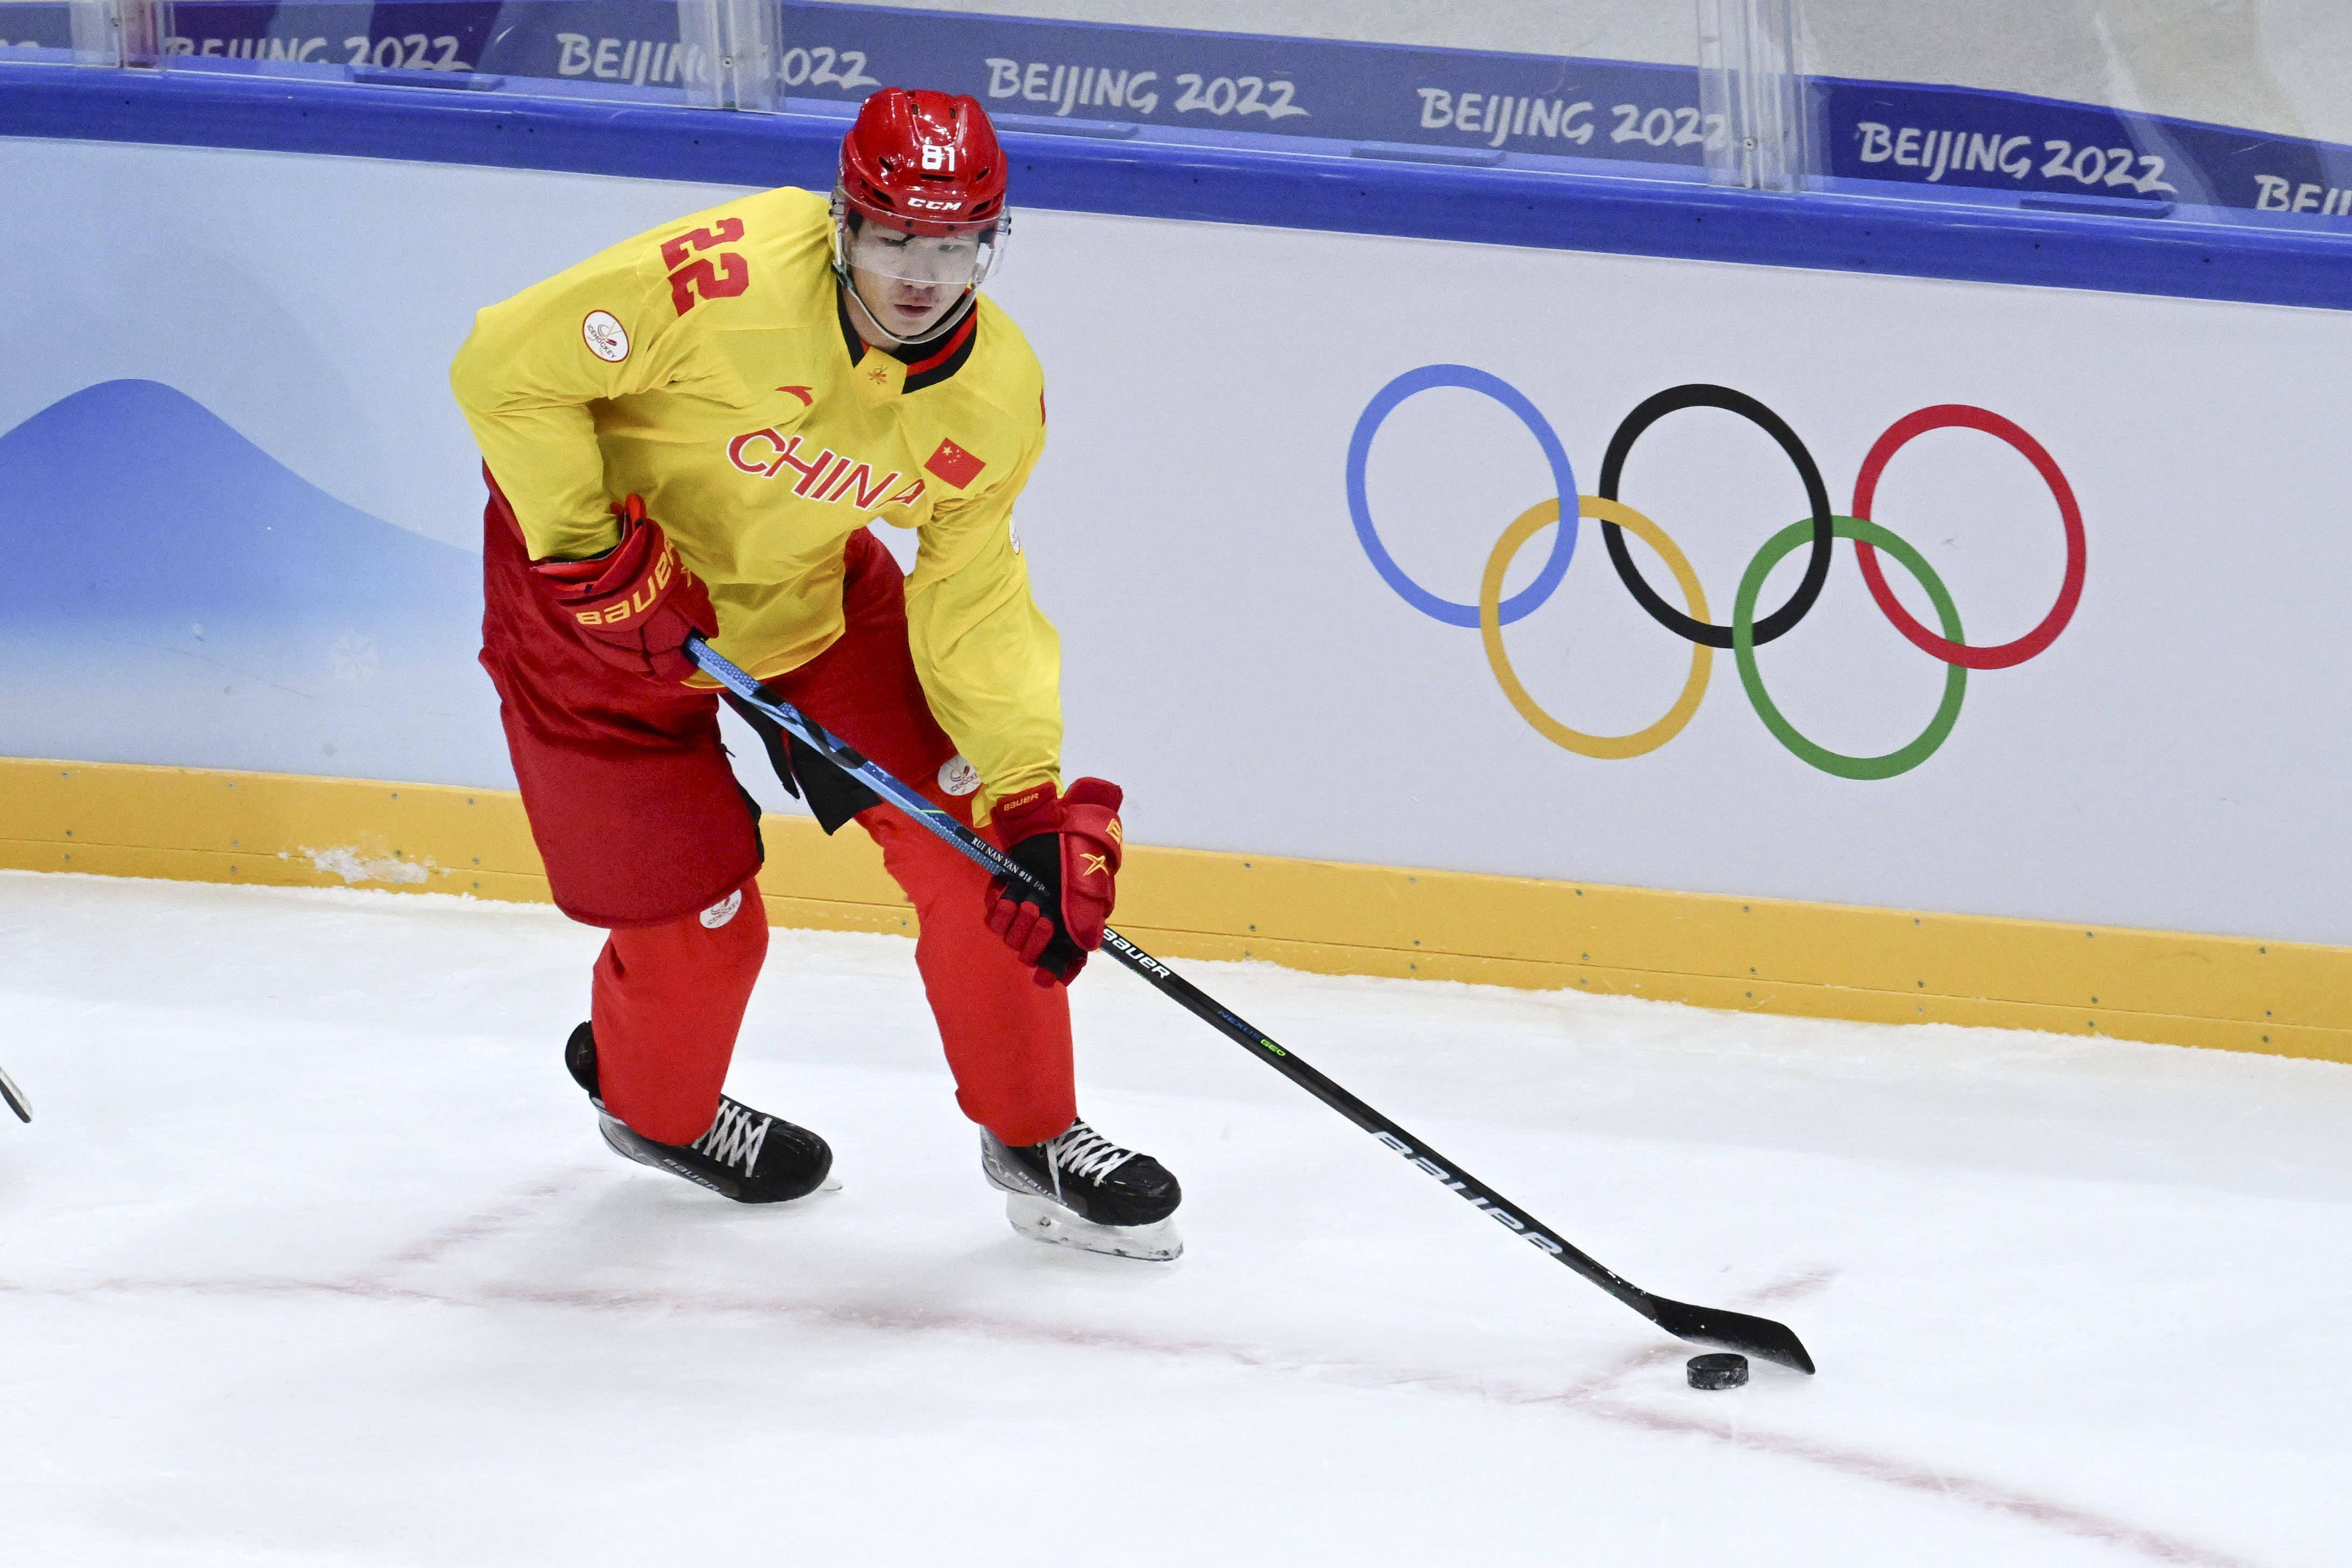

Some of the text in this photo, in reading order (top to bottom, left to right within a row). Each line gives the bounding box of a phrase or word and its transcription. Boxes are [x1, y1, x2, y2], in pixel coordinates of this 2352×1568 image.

[344, 34, 474, 71] 2022
[760, 44, 882, 89] 022
[985, 58, 1312, 120] BEIJING 2022
[1417, 88, 1594, 147] BEIJING
[921, 144, 955, 172] 81
[1856, 122, 2178, 194] BEIJING 2022
[907, 197, 962, 211] CCM
[660, 217, 749, 317] 22
[727, 426, 926, 511] CHINA
[972, 837, 1032, 883] RUI NAN YAN #18
